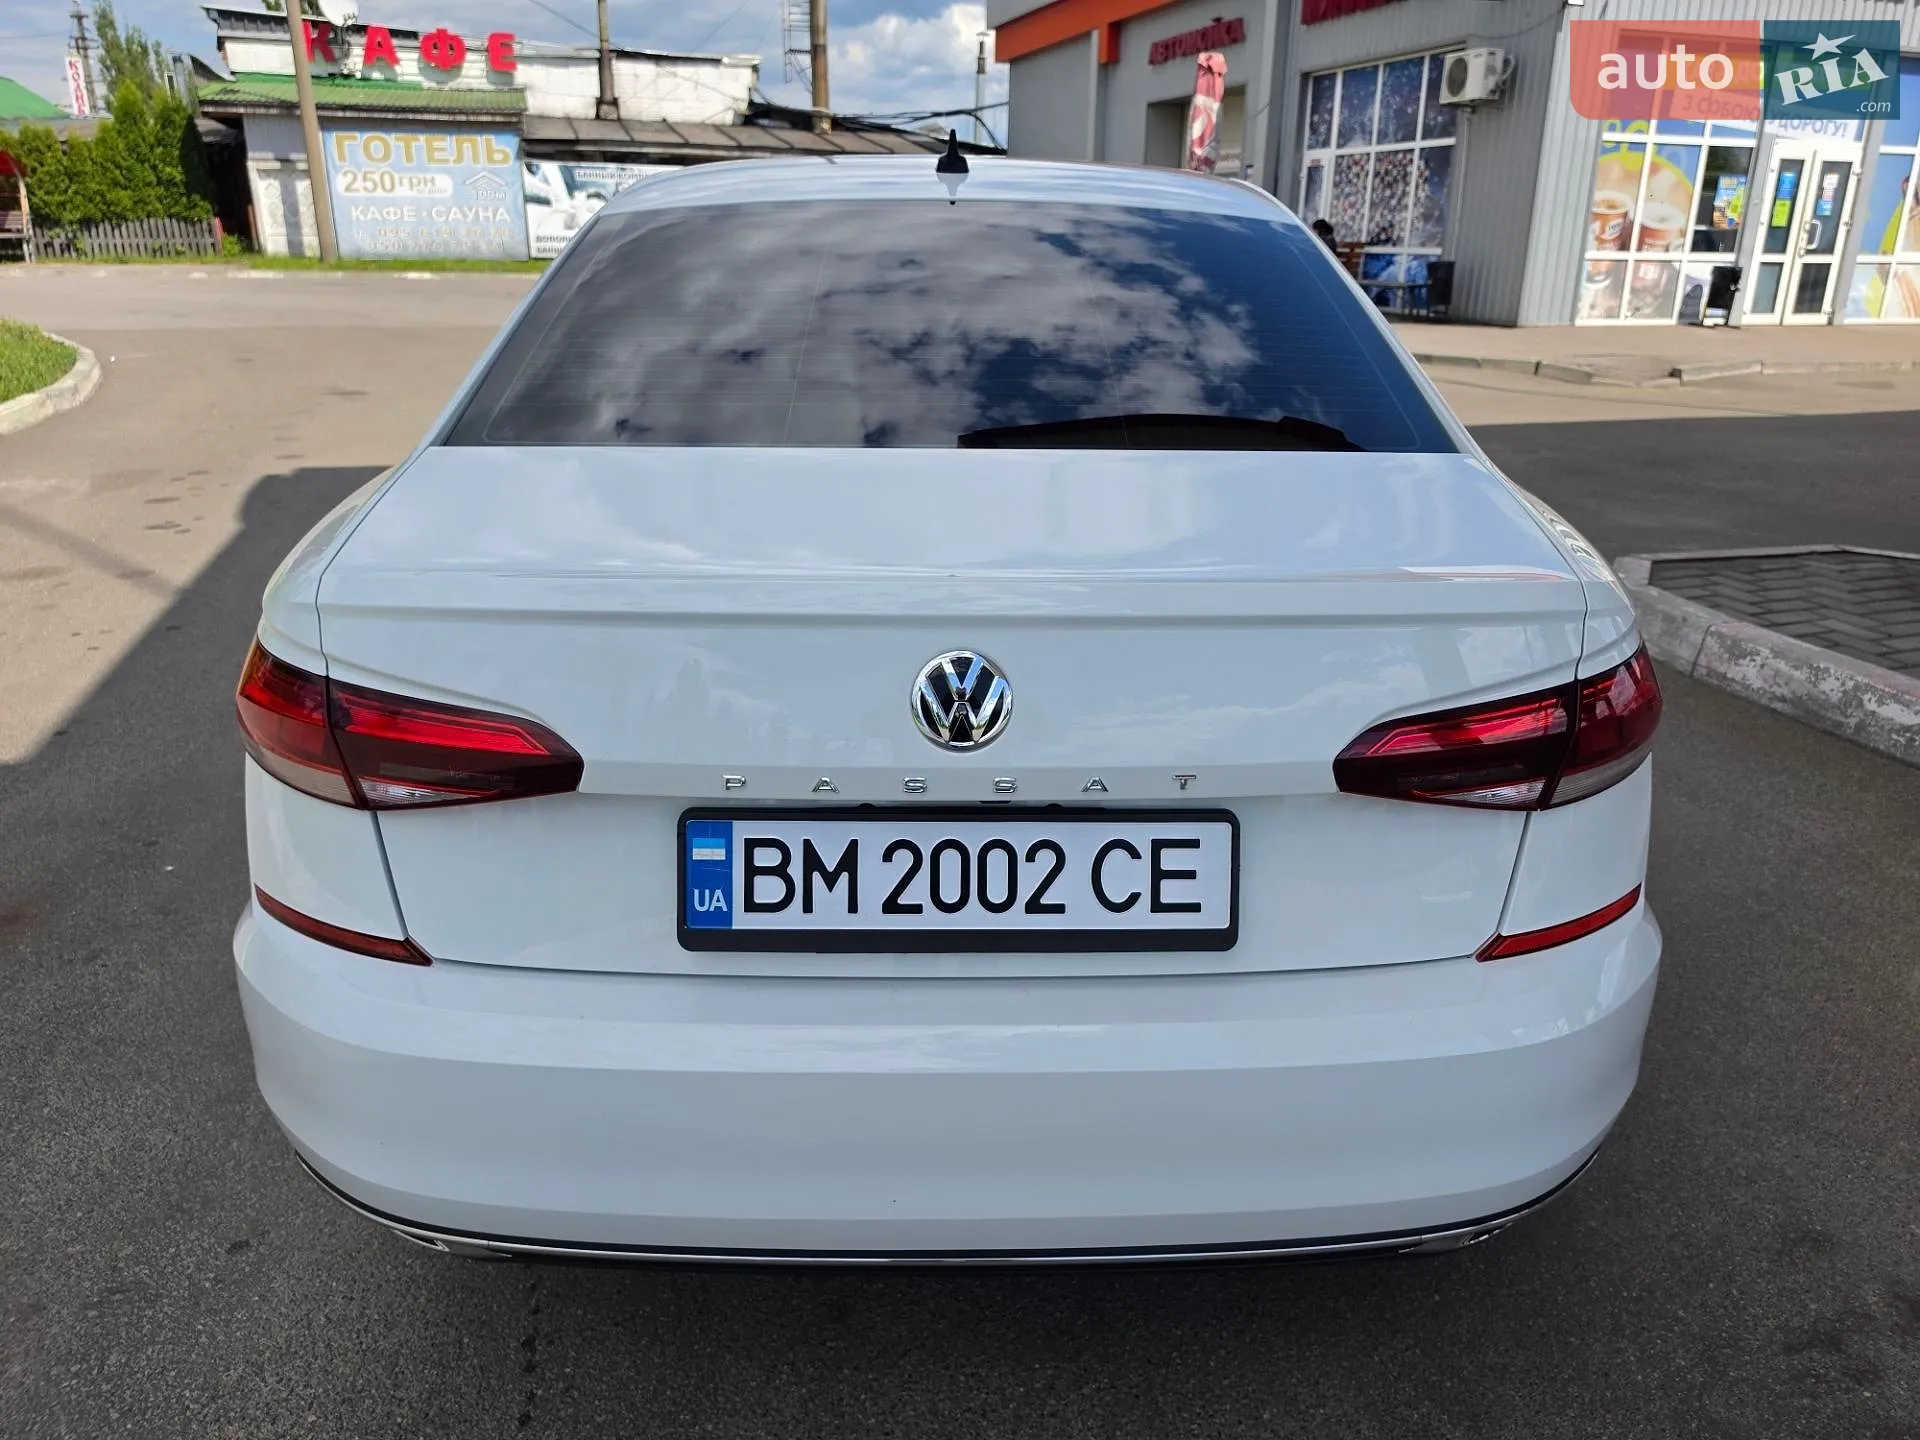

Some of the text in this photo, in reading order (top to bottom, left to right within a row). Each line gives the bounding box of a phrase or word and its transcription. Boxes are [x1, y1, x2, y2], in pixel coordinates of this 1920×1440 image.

[302, 18, 518, 72] КАФЕ
[334, 133, 513, 167] ГОТЕЛЬ
[343, 169, 436, 193] 250 грн
[352, 205, 511, 222] КАФЕ САУНА
[722, 774, 1197, 794] PASSAT
[743, 838, 1202, 914] BM 2002 CE
[693, 889, 728, 912] UA
